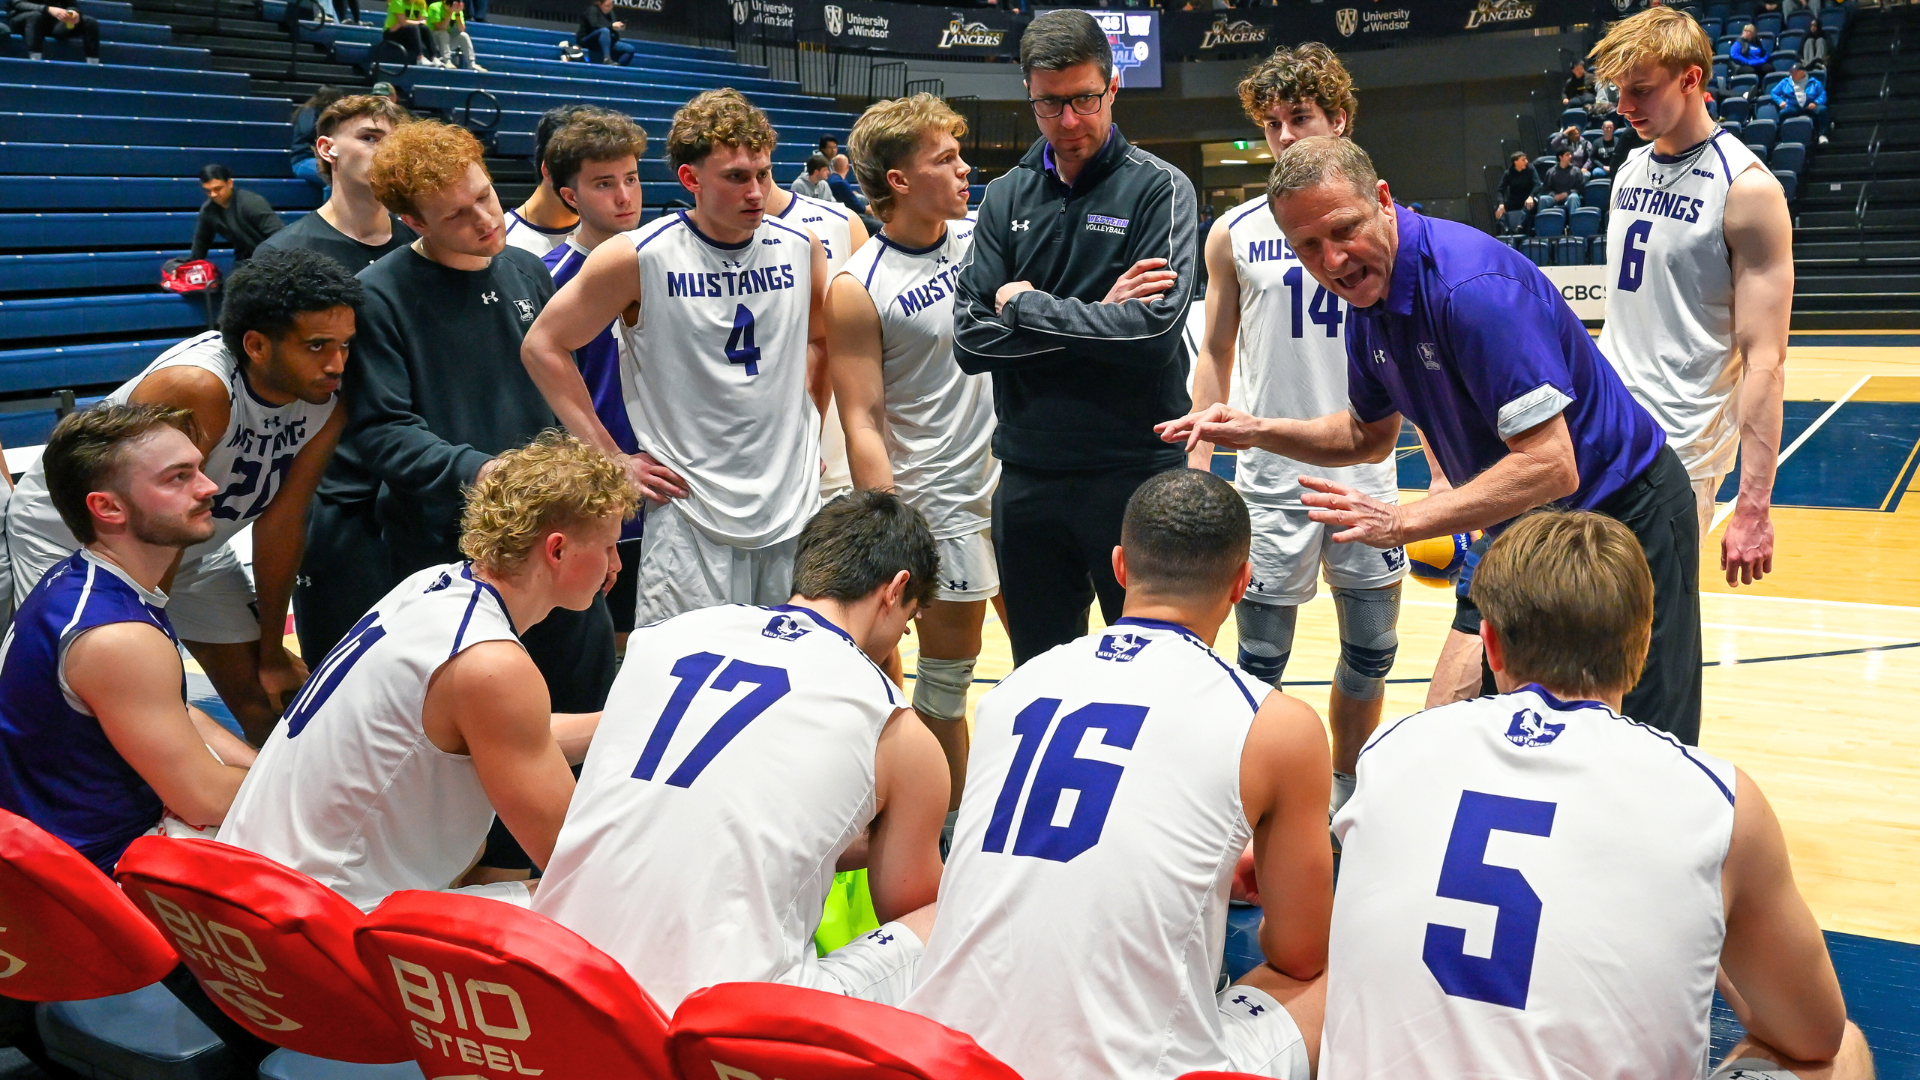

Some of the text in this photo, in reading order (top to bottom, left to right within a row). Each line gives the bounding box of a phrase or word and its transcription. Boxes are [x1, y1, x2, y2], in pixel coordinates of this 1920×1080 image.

[613, 0, 662, 11] ANCERS
[846, 12, 889, 28] University
[1362, 9, 1410, 21] University
[1465, 8, 1532, 29] LANCERS
[853, 24, 889, 39] Windsor
[938, 29, 1001, 48] LANCERS
[1200, 31, 1265, 48] LANCERS
[1370, 20, 1410, 32] Windsor
[1692, 168, 1714, 180] OUA
[1087, 213, 1129, 228] WESTERN
[1613, 187, 1704, 224] MUSTANGS
[1085, 223, 1126, 235] VOLLEYBALL
[1250, 238, 1299, 263] MUS
[1617, 219, 1653, 293] 6
[667, 263, 794, 298] MUSTANGS
[1282, 266, 1343, 339] 14
[723, 303, 761, 377] 4
[283, 610, 387, 740] 10
[630, 651, 791, 789] 17
[982, 697, 1150, 863] 16
[1422, 789, 1557, 1011] 5
[144, 889, 267, 973] BIO
[175, 937, 284, 999] STEEL
[388, 954, 532, 1042] BIO
[410, 1019, 545, 1077] STEEL
